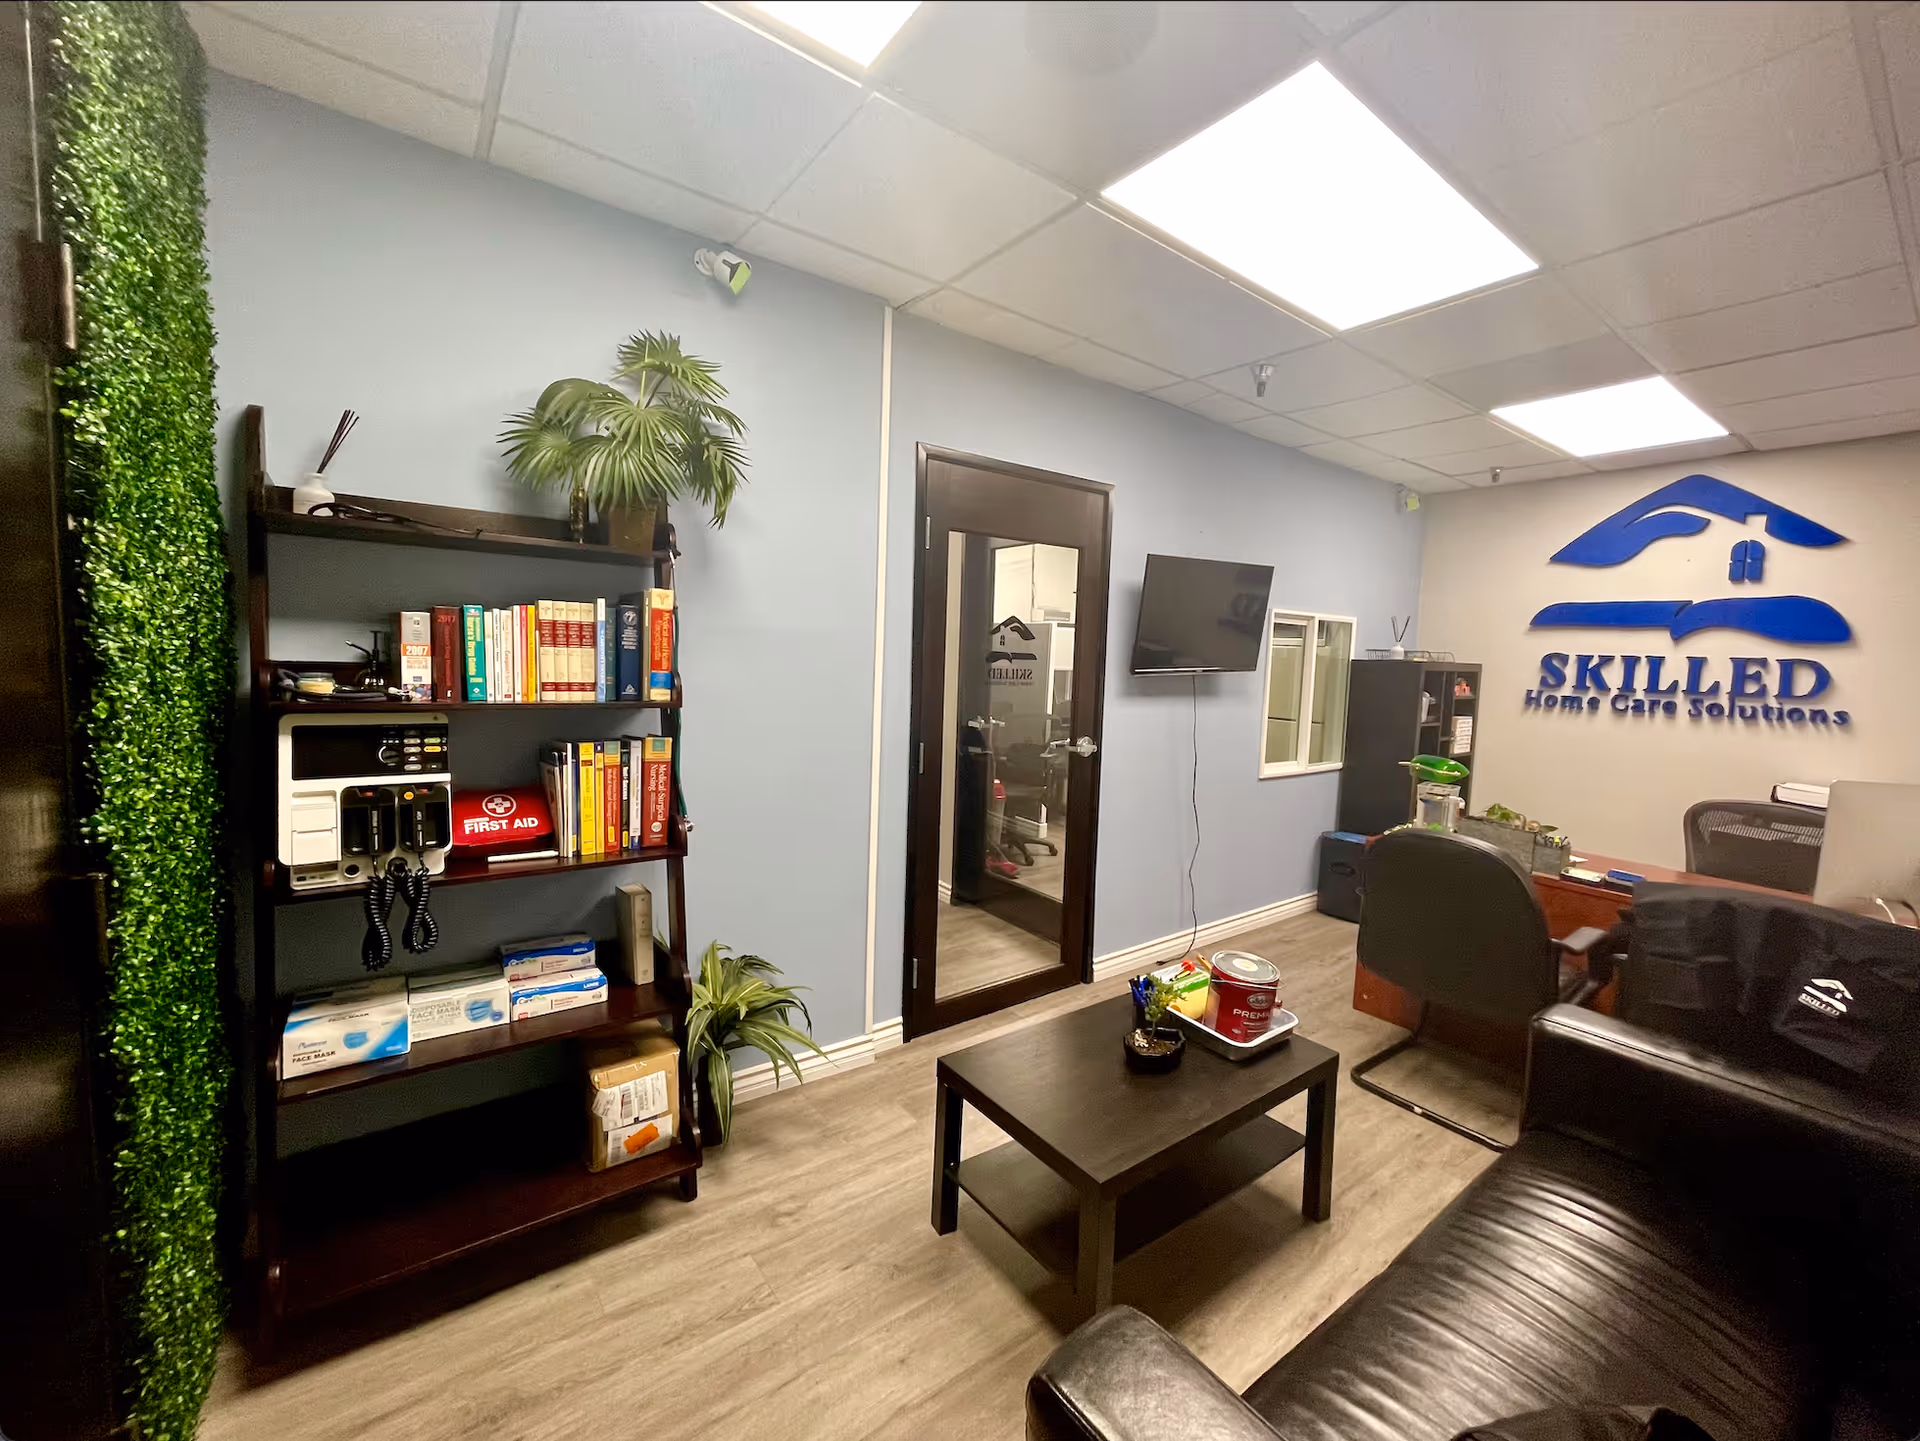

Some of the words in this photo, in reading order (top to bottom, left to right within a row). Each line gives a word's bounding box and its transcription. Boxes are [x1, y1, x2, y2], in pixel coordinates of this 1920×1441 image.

[405, 645, 429, 656] 2007
[1540, 652, 1832, 698] SKILLED
[1524, 689, 1600, 711] Home
[1610, 694, 1677, 714] Care
[1687, 695, 1850, 726] Solutions
[648, 764, 658, 791] Nursing
[464, 820, 509, 835] FIRST
[513, 817, 539, 829] AID
[436, 1006, 462, 1016] MASK
[292, 1055, 314, 1064] FACE
[314, 1050, 336, 1060] MASK
